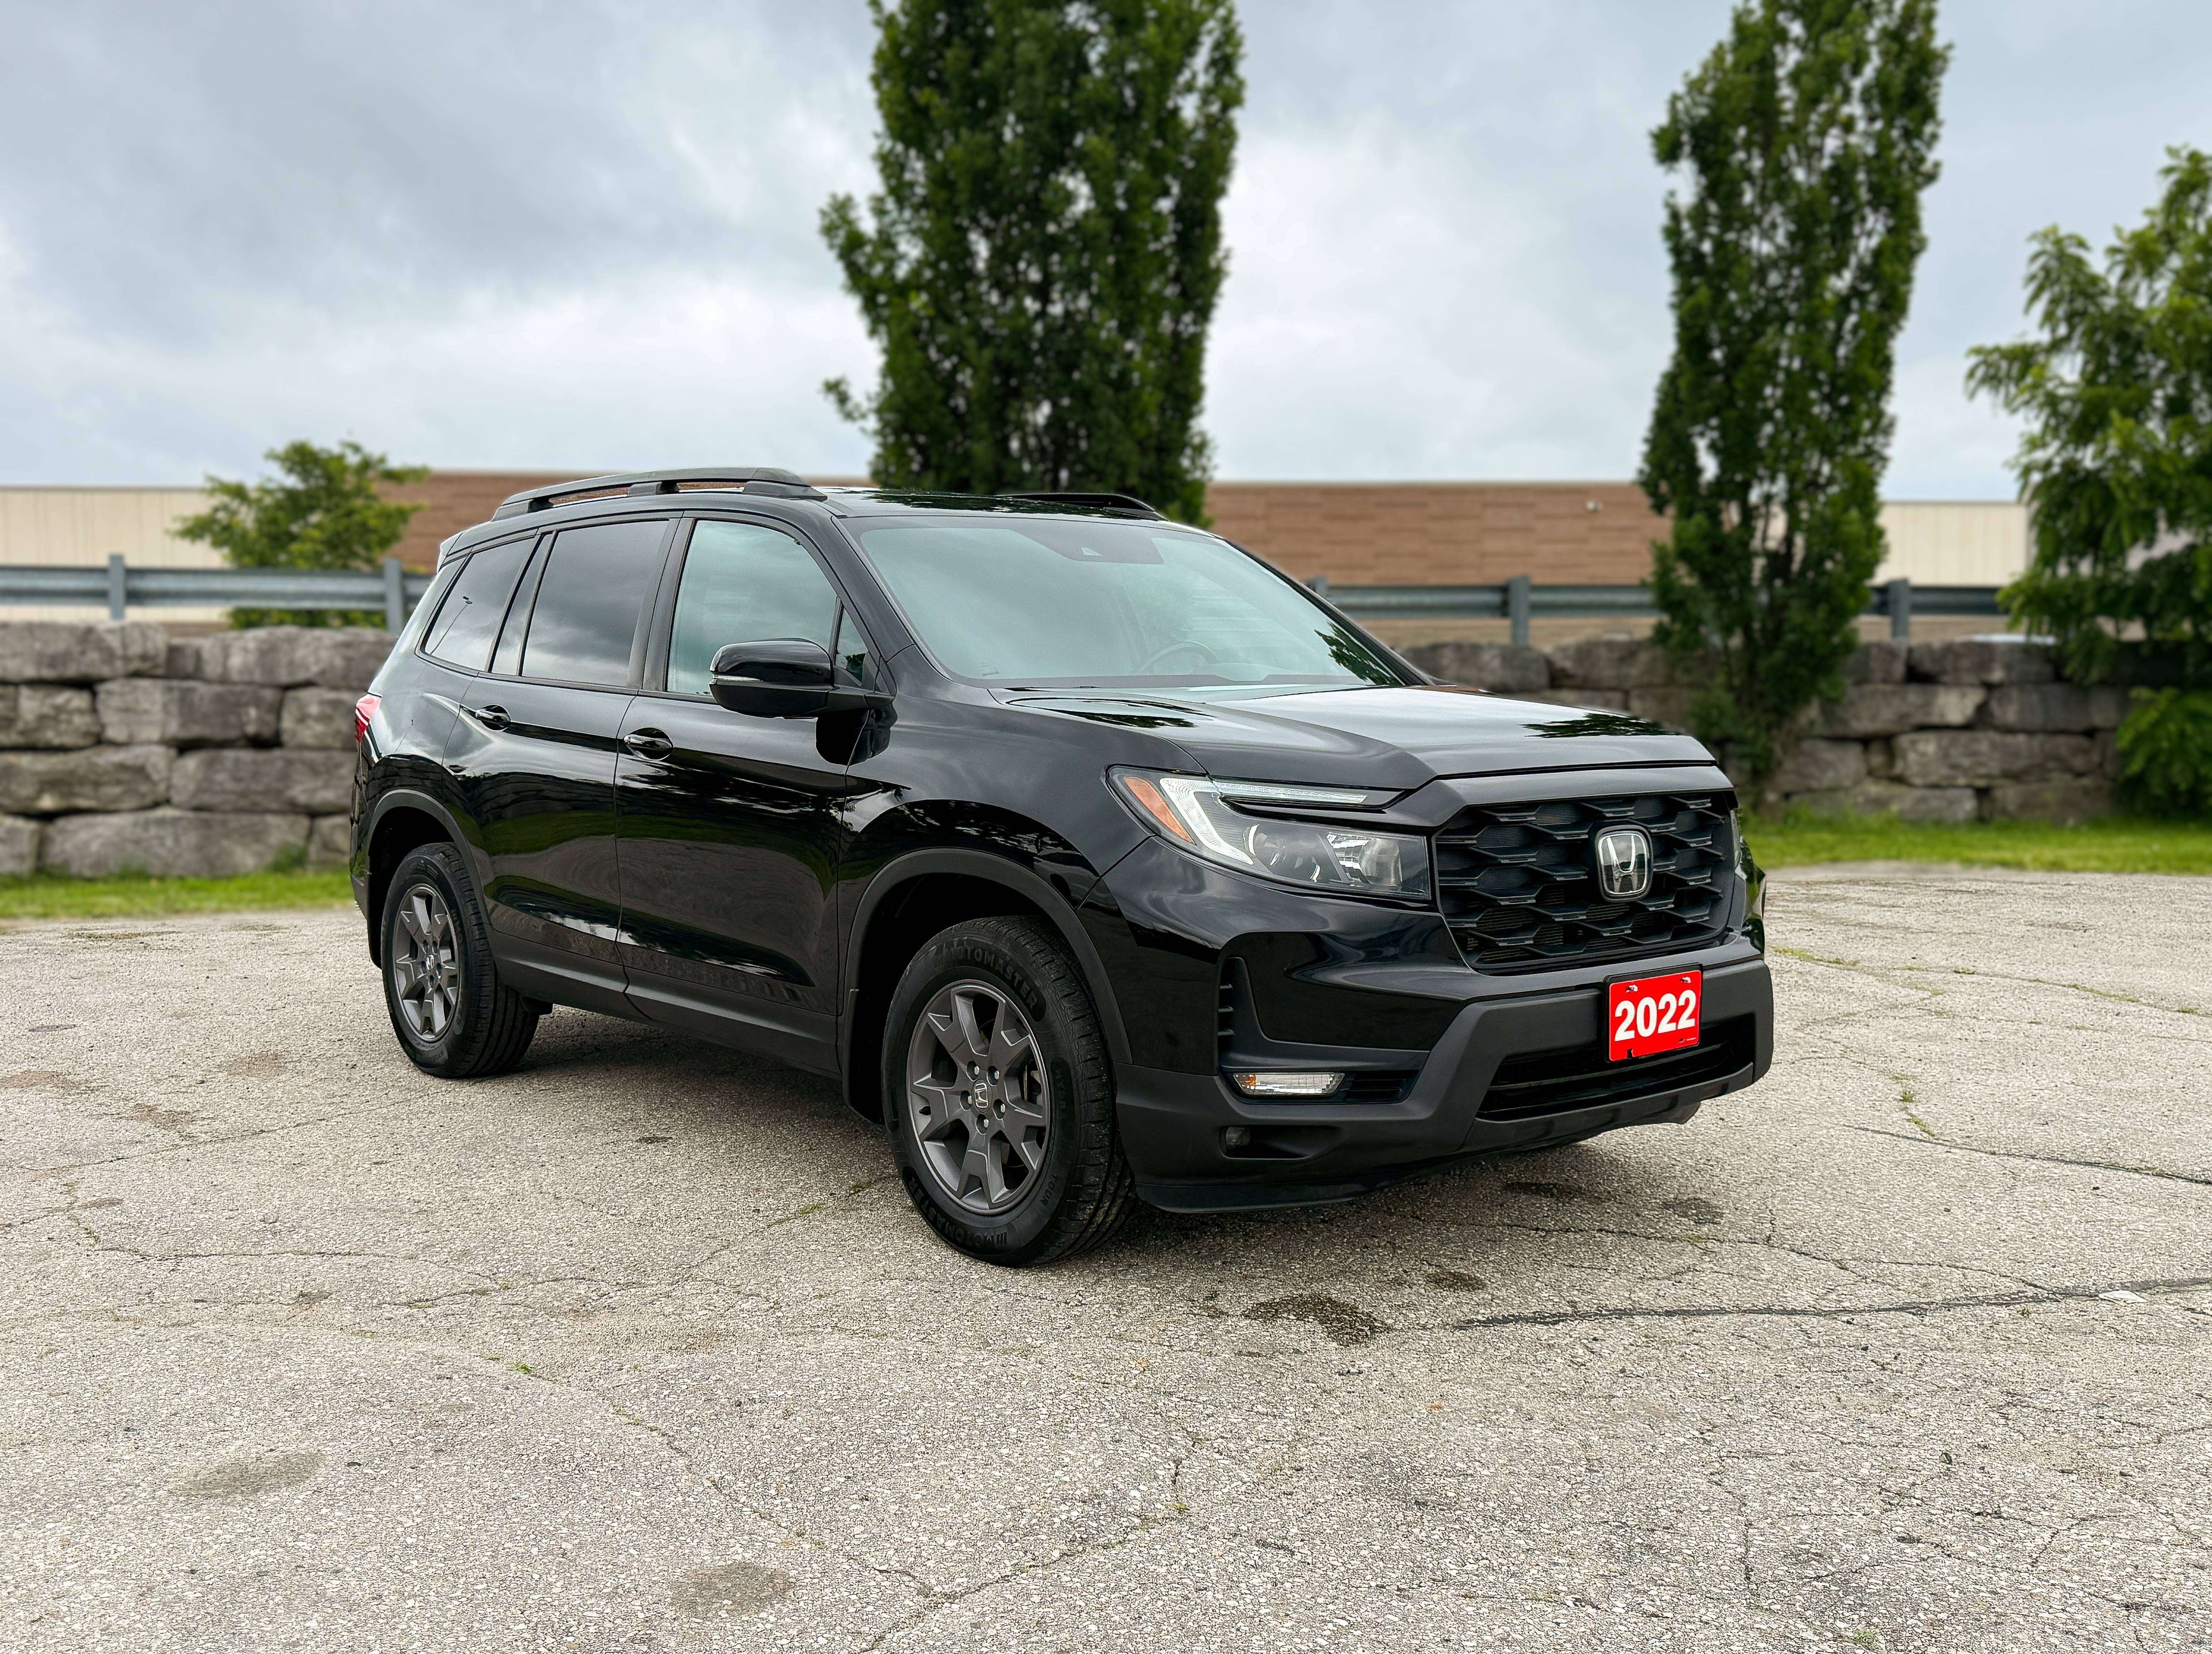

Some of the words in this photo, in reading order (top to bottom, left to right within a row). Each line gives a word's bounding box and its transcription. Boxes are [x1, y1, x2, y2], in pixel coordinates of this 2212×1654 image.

[944, 945, 1037, 1009] MOTOMASTER
[1614, 989, 1696, 1041] 2022
[1040, 1174, 1059, 1206] TOUR
